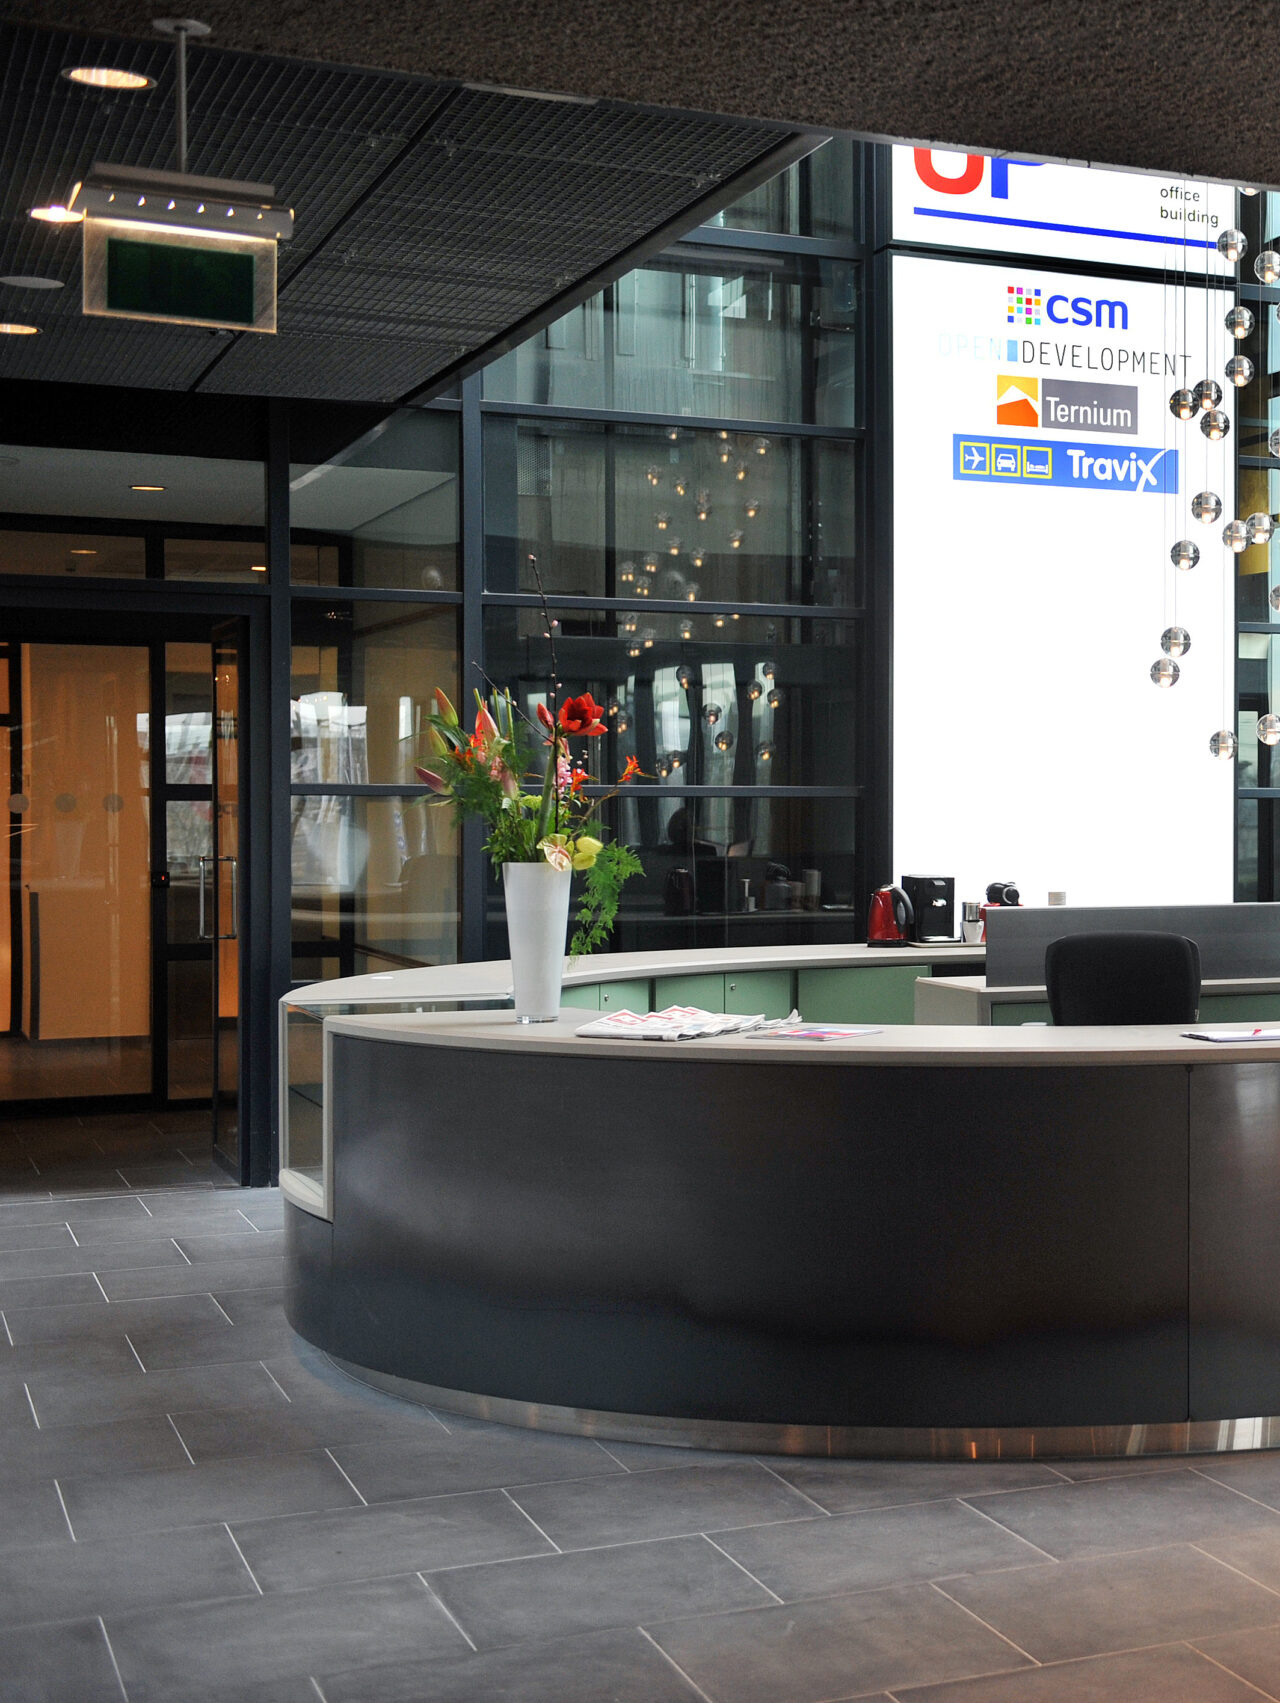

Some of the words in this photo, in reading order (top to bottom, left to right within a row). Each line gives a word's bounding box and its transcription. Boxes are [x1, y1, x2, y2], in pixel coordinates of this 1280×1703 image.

[1160, 186, 1200, 203] office
[1160, 206, 1219, 228] building
[1046, 294, 1129, 330] csm
[1022, 339, 1192, 378] DEVELOPMENT
[1046, 396, 1132, 428] Ternium
[1067, 447, 1171, 492] Travix
